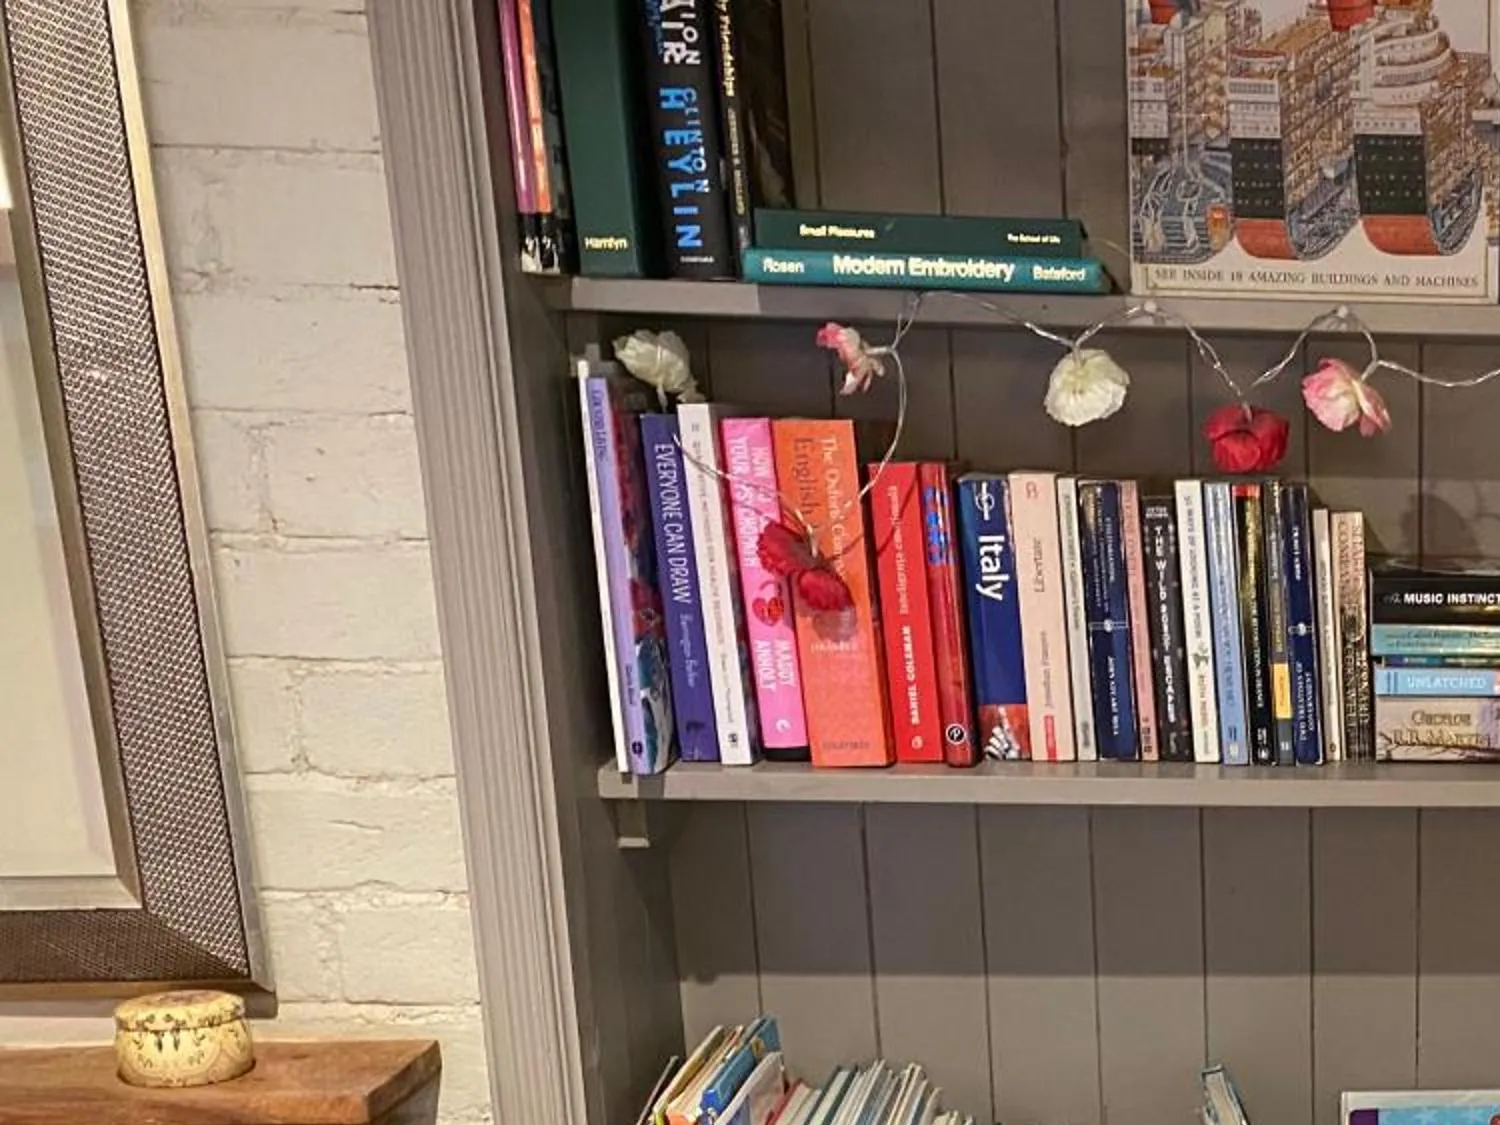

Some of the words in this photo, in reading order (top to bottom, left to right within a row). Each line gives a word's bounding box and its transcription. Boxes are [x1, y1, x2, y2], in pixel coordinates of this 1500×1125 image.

[683, 88, 710, 193] CLINTON
[660, 88, 703, 248] HEYLIN
[584, 237, 628, 251] Hamlyn
[763, 258, 805, 273] Rosen
[833, 255, 904, 277] Modern
[909, 257, 1016, 283] Embroidery
[1155, 270, 1177, 281] SEE
[1183, 271, 1223, 282] INSIDE
[1249, 273, 1305, 284] AMAZING
[1311, 274, 1379, 285] BUILDINGS
[1385, 276, 1410, 286] AND
[1415, 276, 1478, 288] MACHINES
[728, 436, 751, 475] YOUR
[750, 445, 770, 478] HOW
[819, 435, 839, 462] The
[652, 442, 683, 521] EVERYONE
[786, 435, 825, 515] English
[663, 522, 685, 555] CAN
[1153, 525, 1164, 557] THE
[667, 556, 693, 605] DRAW
[976, 536, 1011, 602] Italy
[1155, 559, 1168, 601] WILD
[1404, 593, 1443, 604] MUSIC
[1159, 603, 1171, 652] ROBOT
[1407, 676, 1487, 689] UNLATCHED
[907, 684, 920, 724] DANIEL
